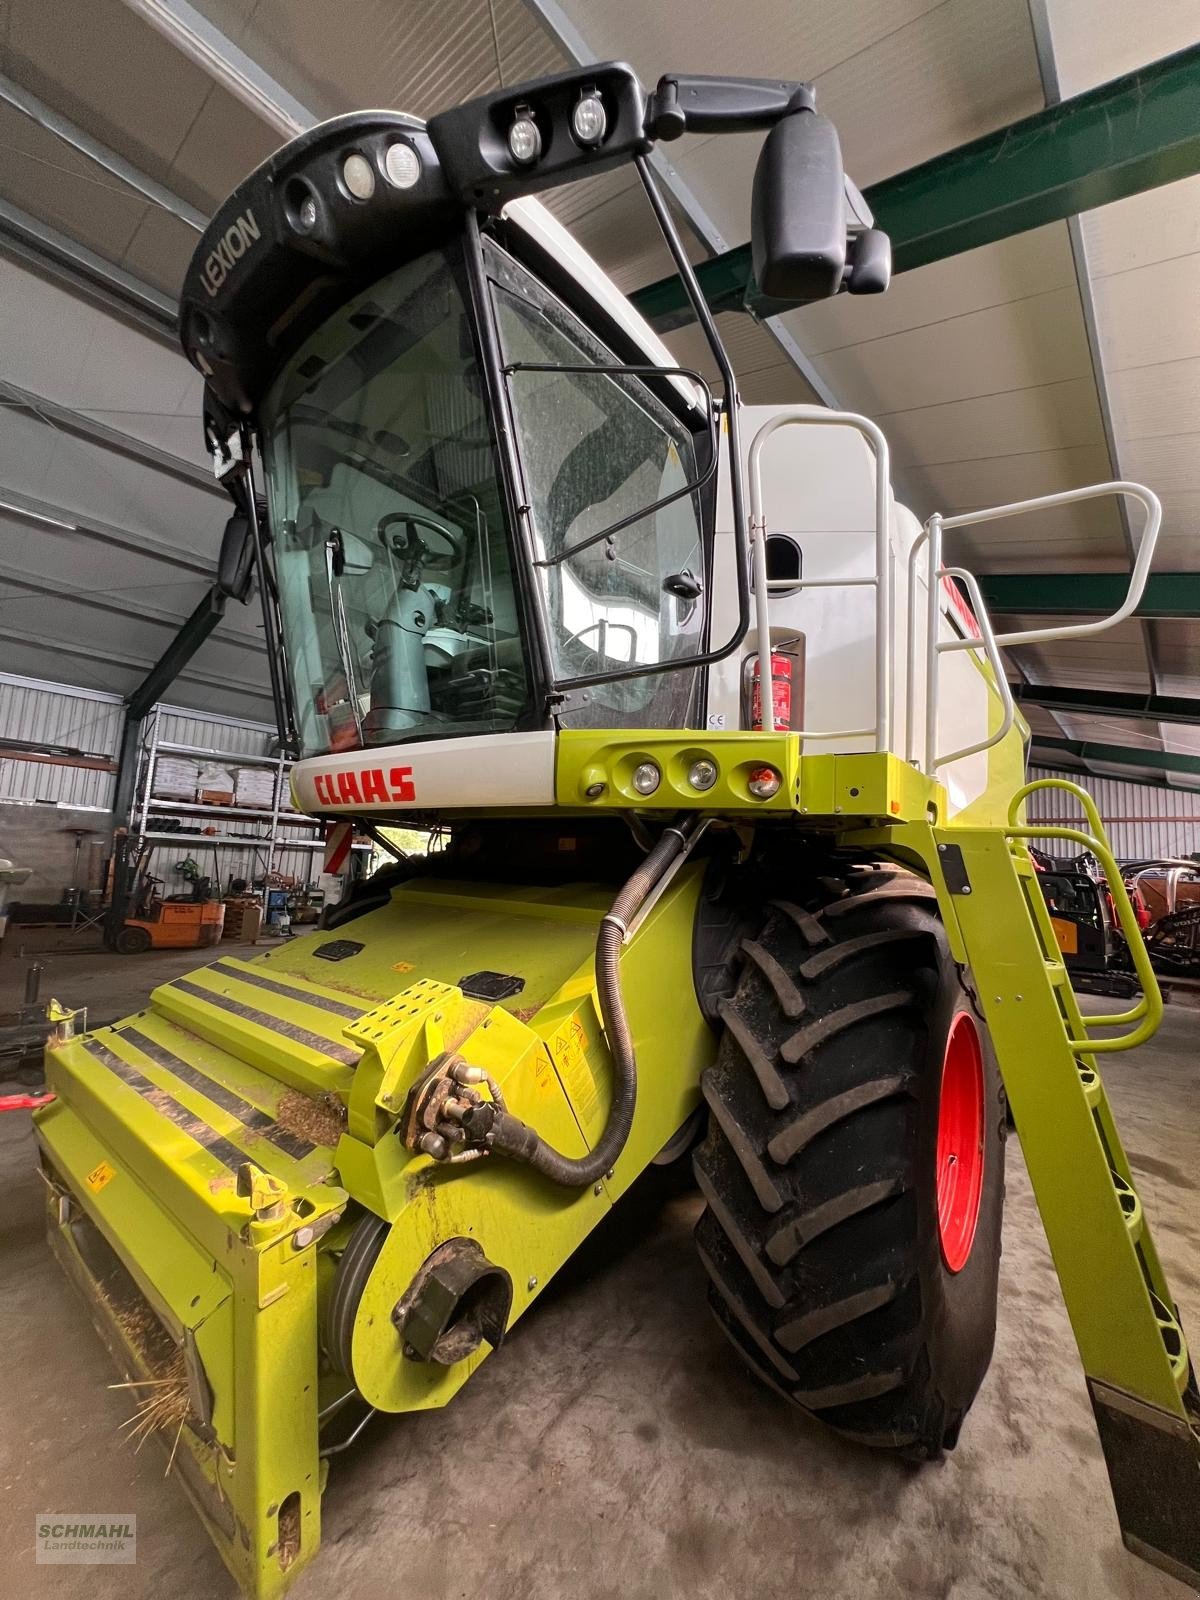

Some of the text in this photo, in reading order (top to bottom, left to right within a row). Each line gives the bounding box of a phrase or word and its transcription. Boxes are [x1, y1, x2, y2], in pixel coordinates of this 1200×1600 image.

[200, 208, 261, 297] LEXION
[709, 714, 723, 725] CE
[313, 766, 416, 806] CLAAS
